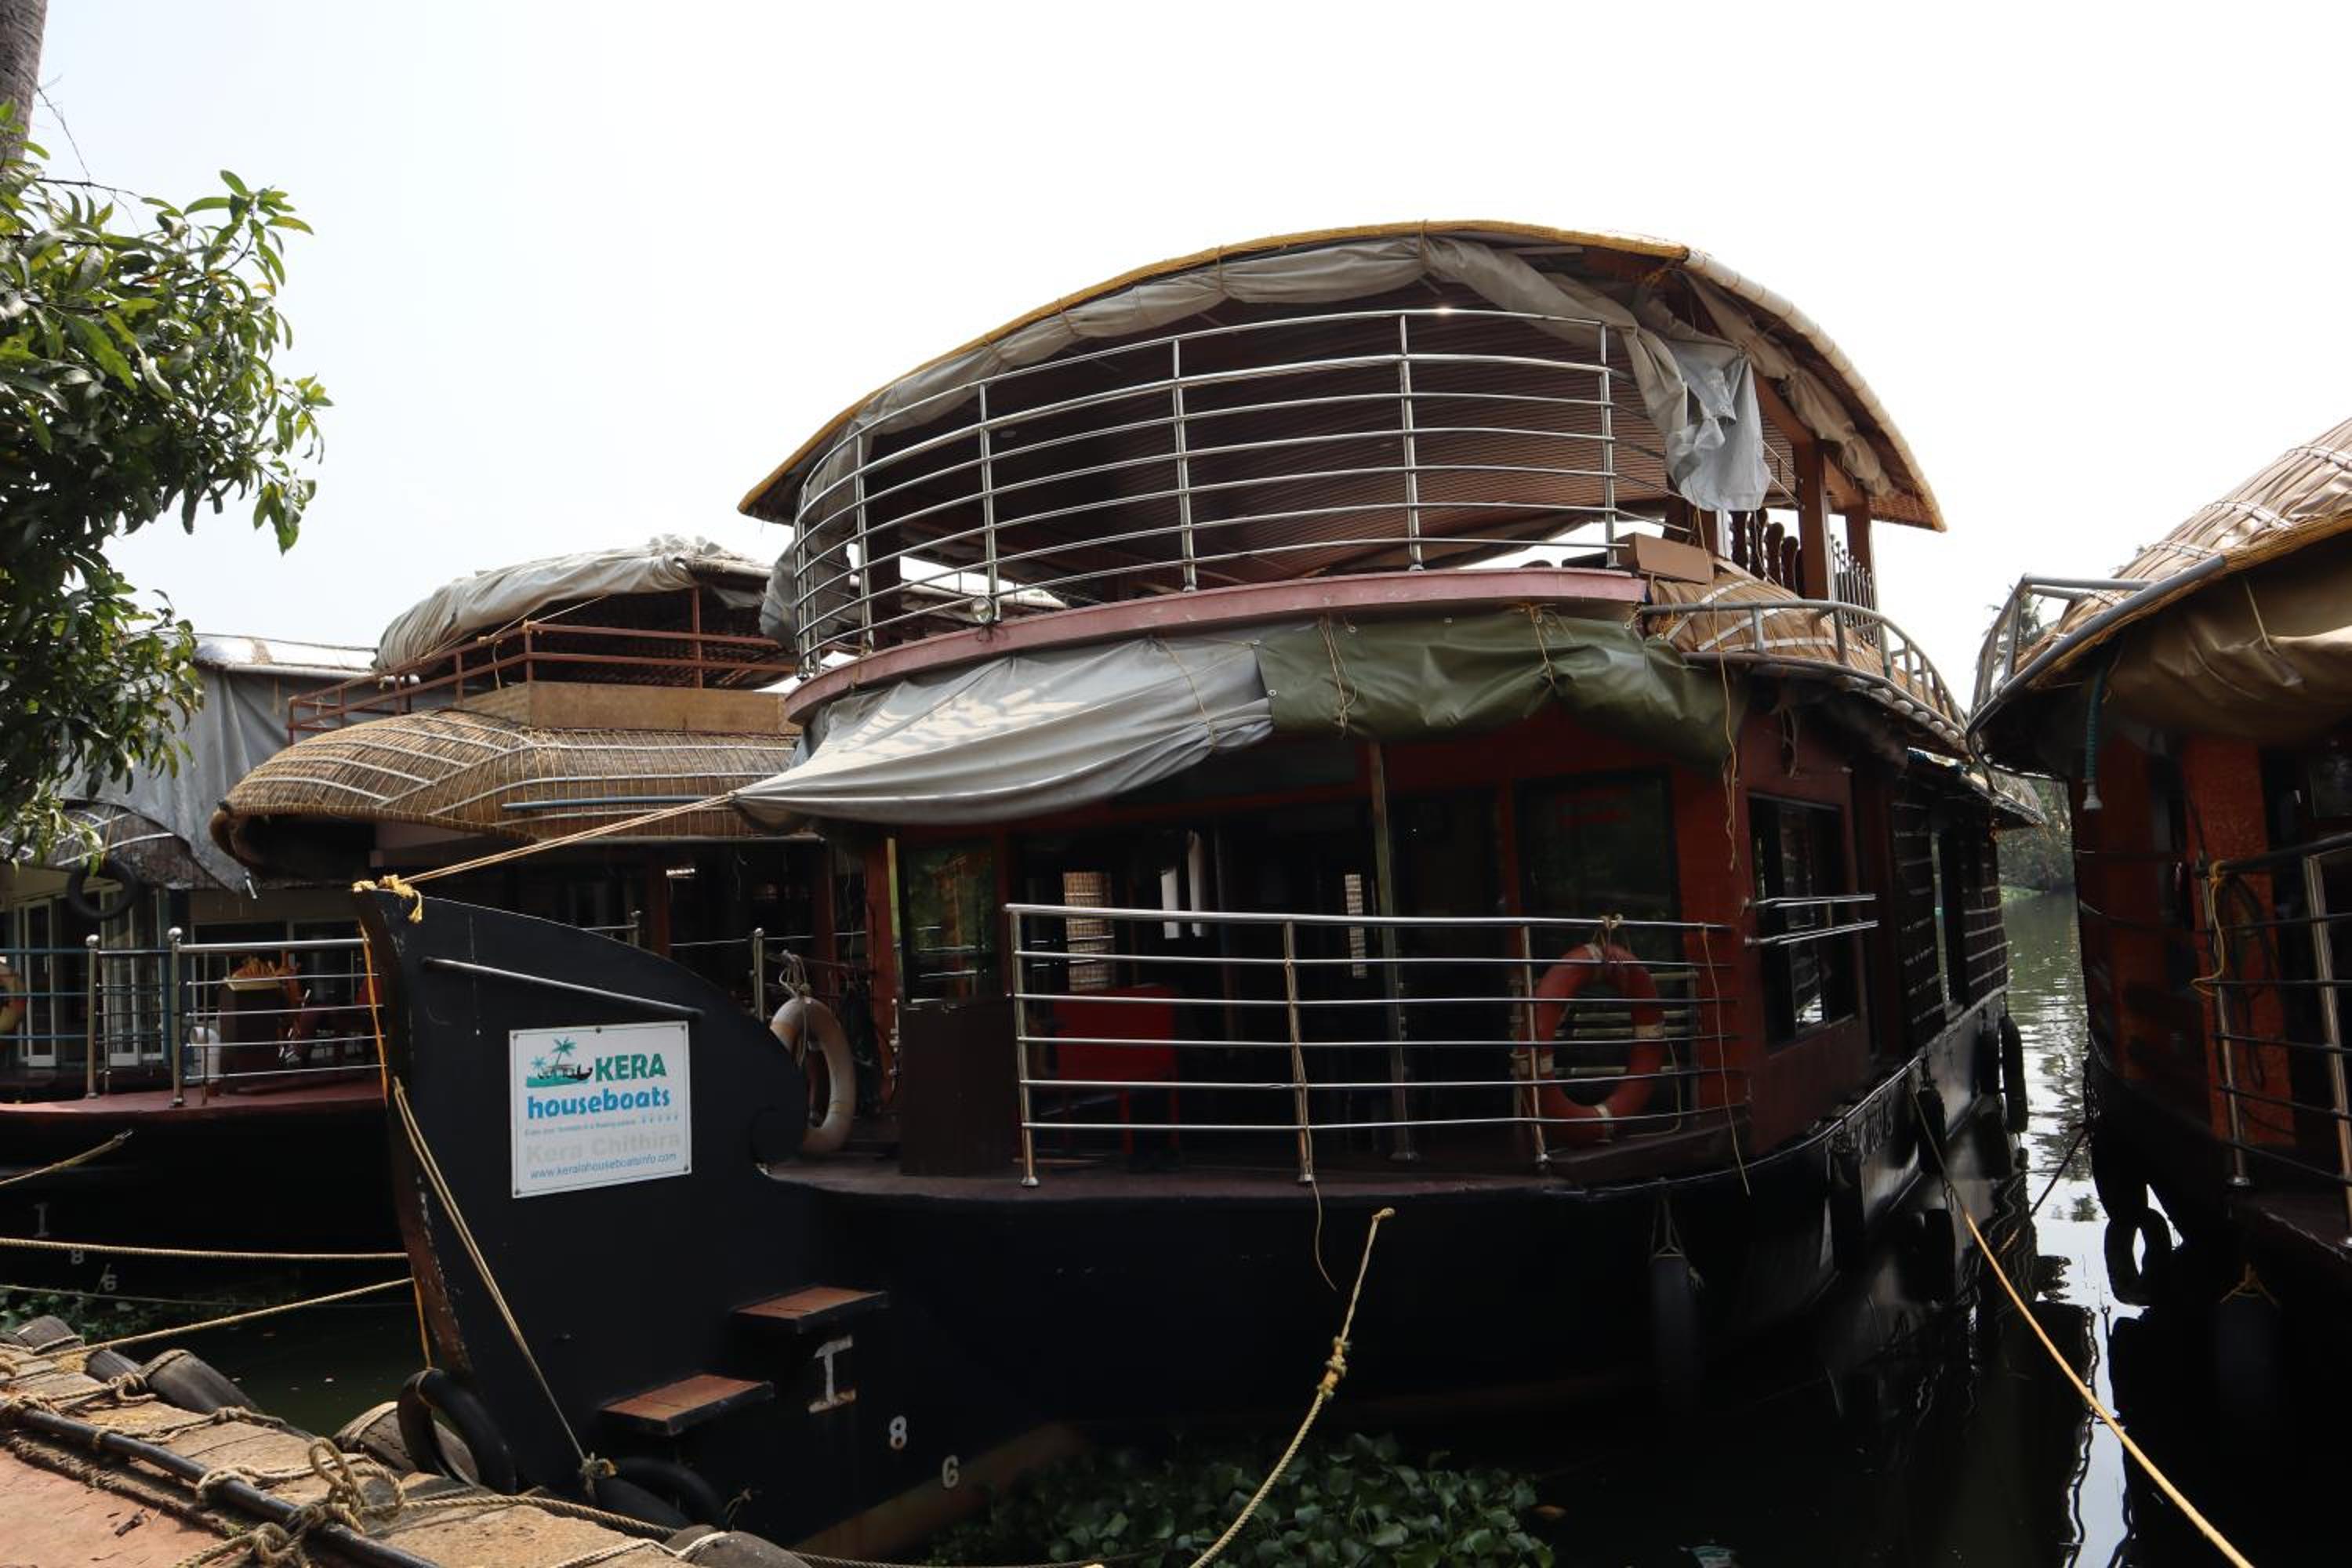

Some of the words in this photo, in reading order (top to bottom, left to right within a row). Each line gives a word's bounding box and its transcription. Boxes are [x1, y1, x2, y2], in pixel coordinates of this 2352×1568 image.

[595, 1054, 666, 1082] KERA
[528, 1087, 670, 1119] houseboats
[887, 1414, 909, 1450] 8
[941, 1454, 959, 1488] 6
